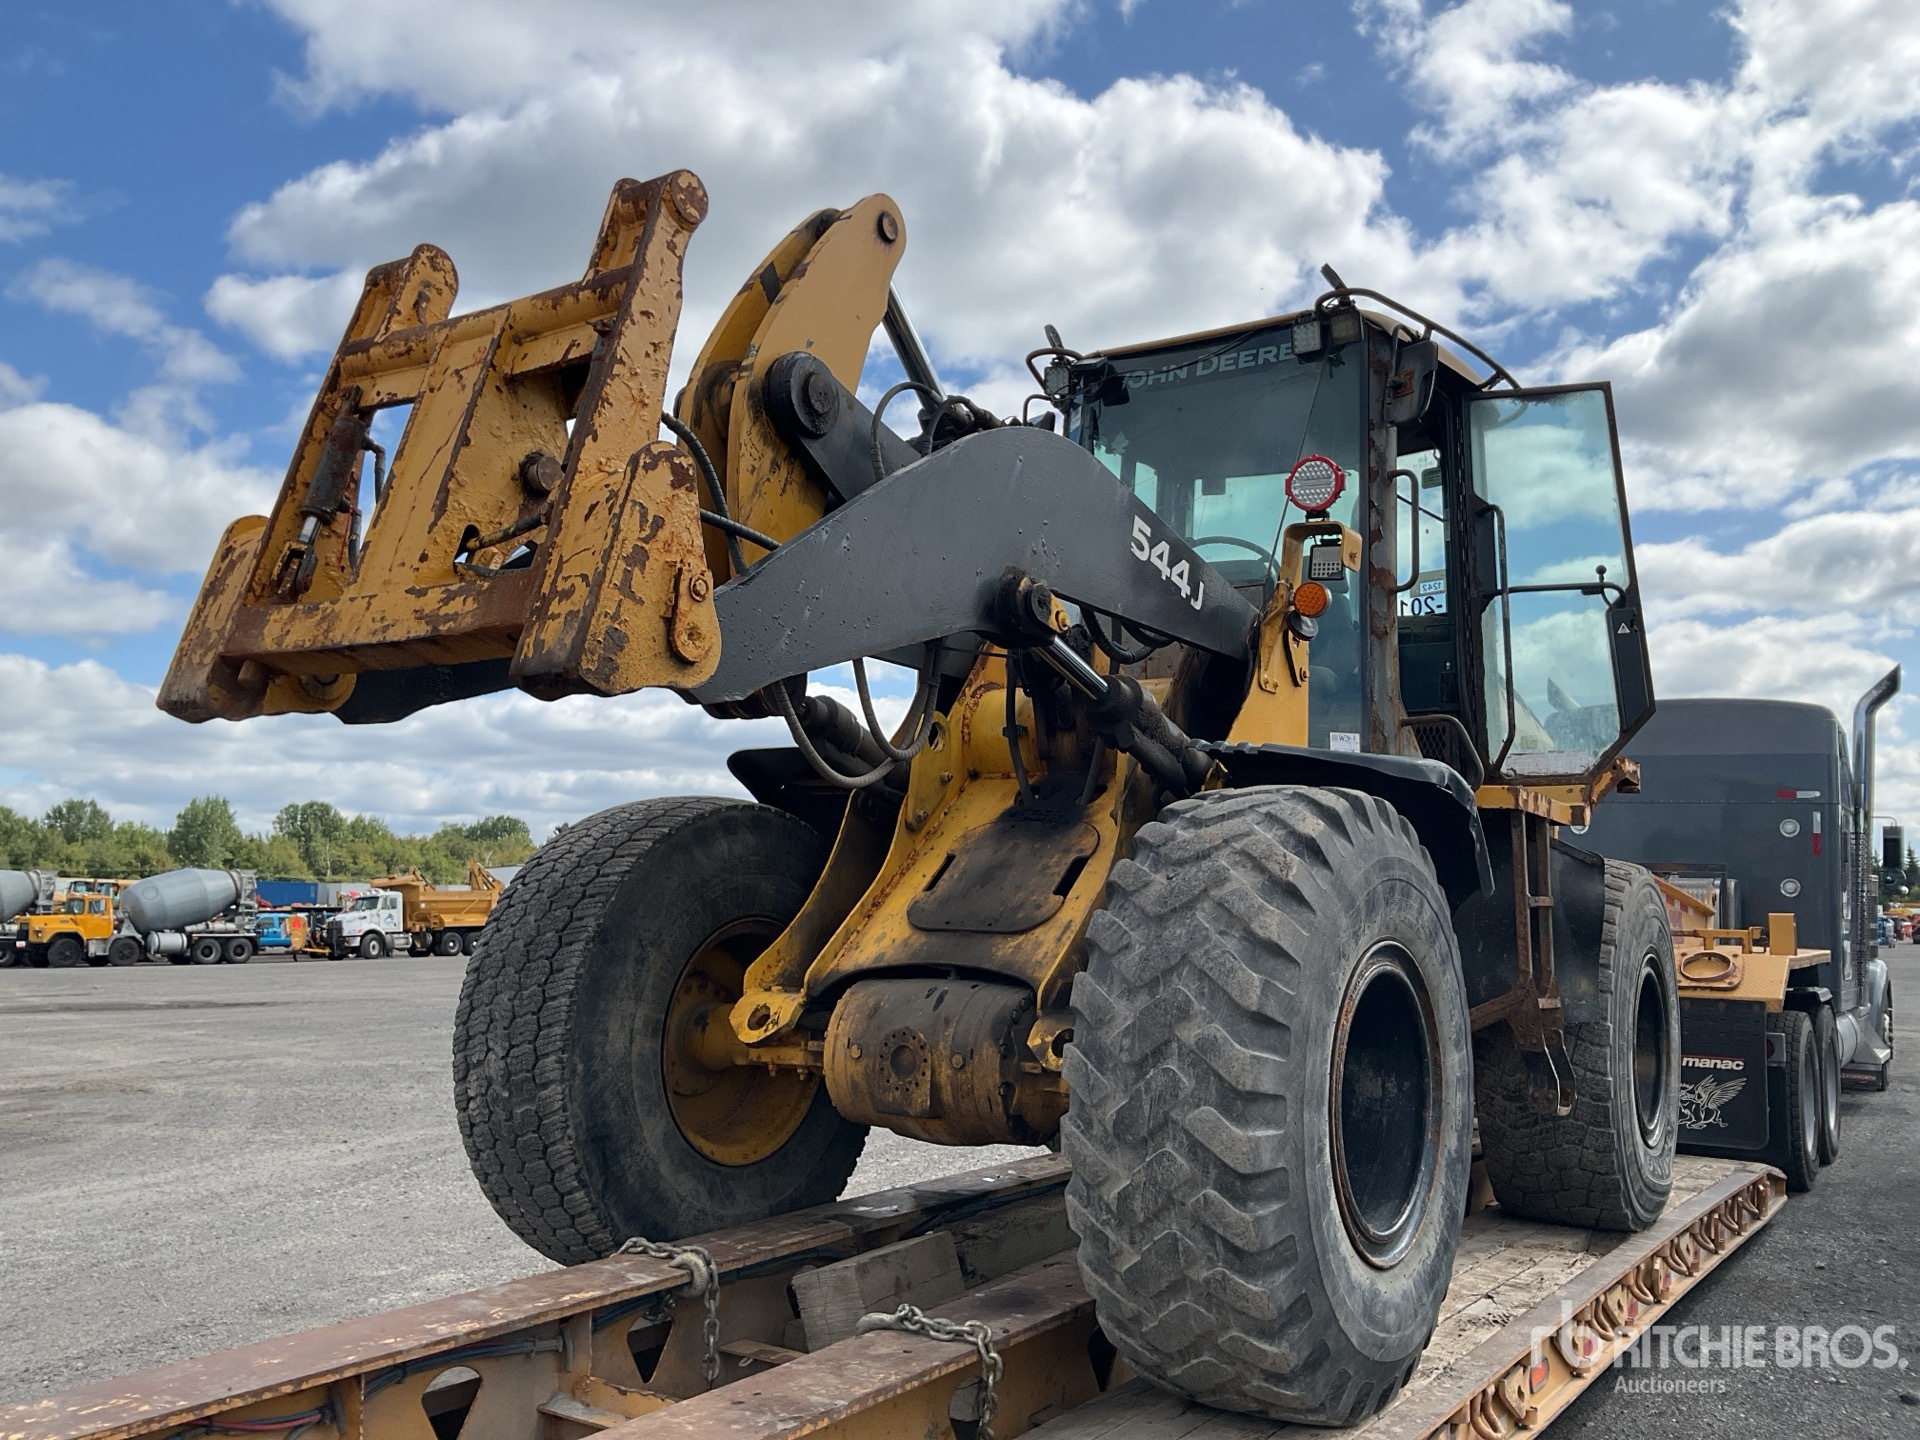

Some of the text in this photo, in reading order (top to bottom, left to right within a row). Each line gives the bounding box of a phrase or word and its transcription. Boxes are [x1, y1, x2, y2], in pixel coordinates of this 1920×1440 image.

[1196, 342, 1296, 376] DEERE
[1130, 515, 1204, 610] 544J
[1682, 1057, 1745, 1071] manac
